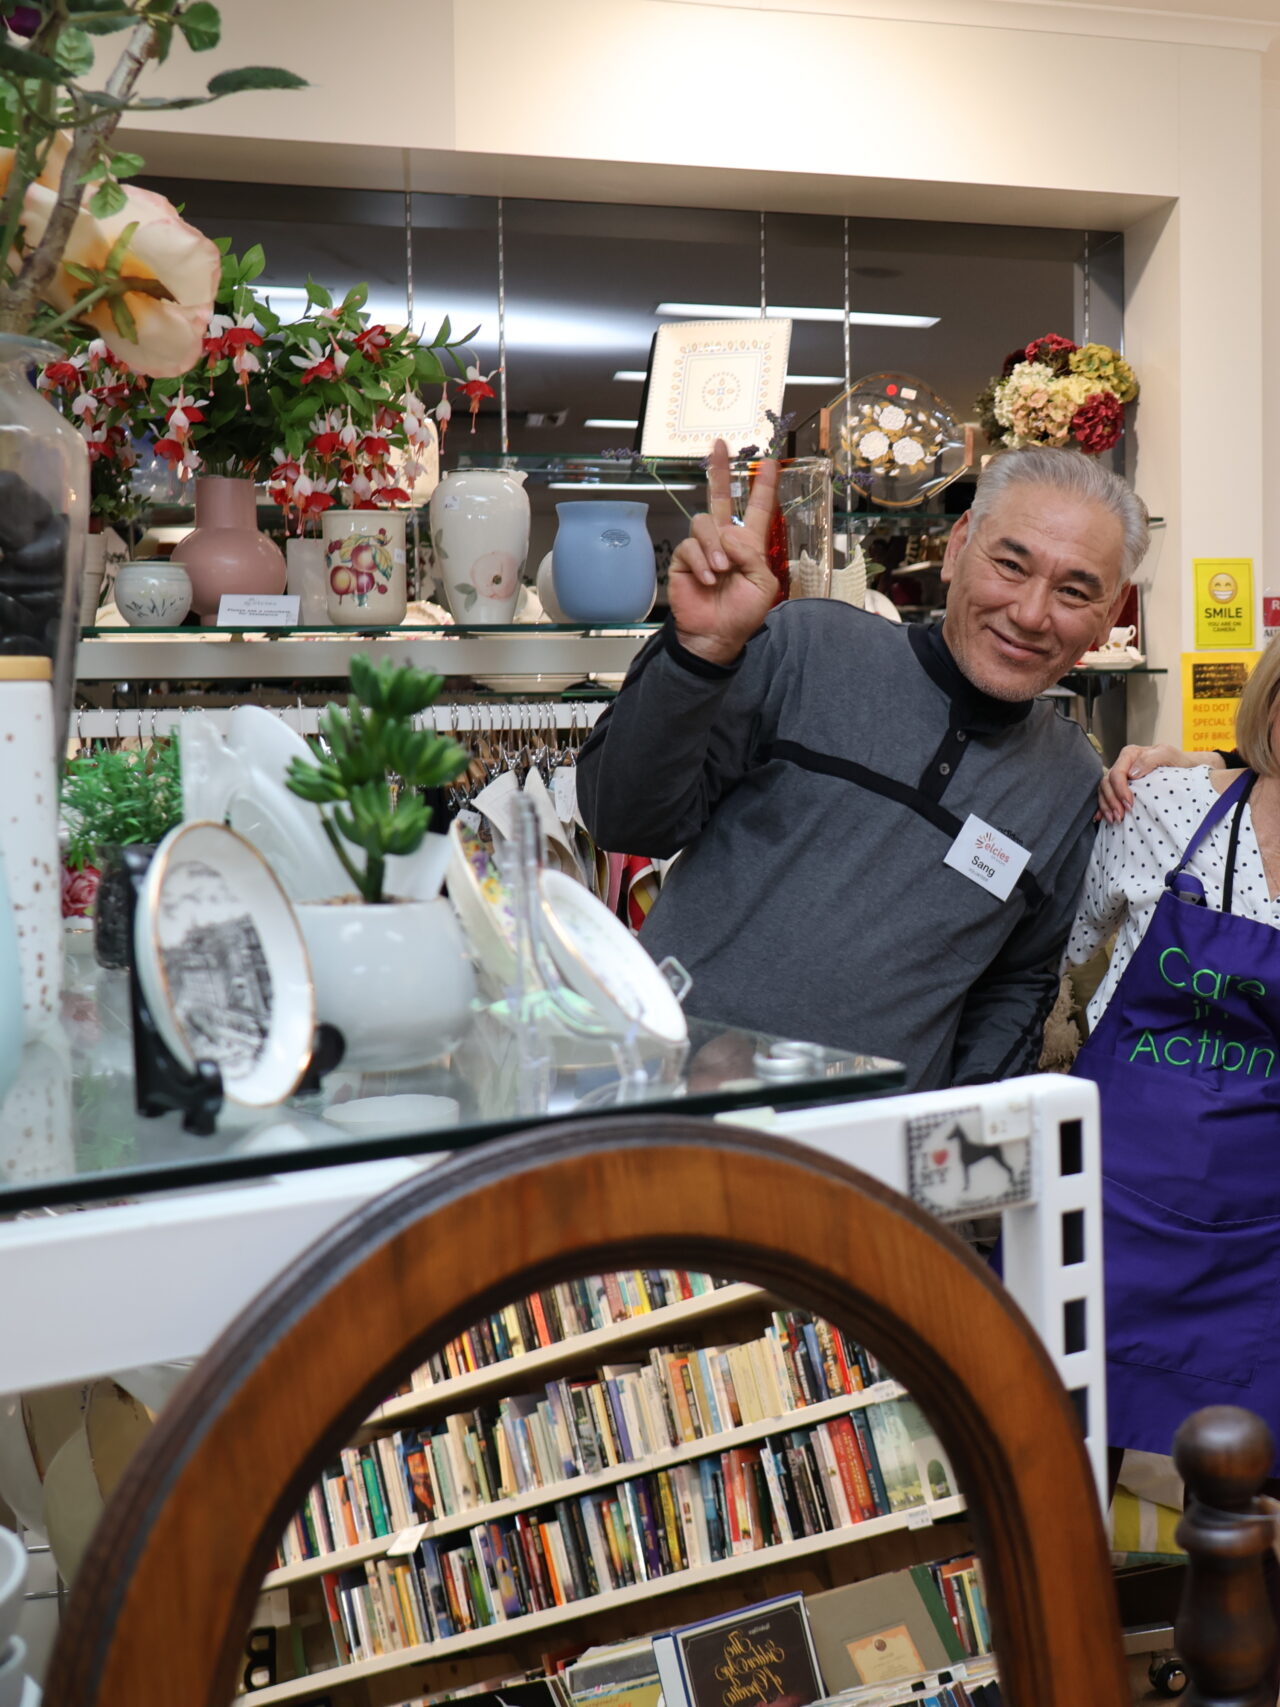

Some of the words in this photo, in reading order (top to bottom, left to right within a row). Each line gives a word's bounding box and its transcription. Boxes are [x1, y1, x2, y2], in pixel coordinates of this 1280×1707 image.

[1204, 607, 1243, 618] SMILE
[1193, 703, 1210, 712] RED
[1212, 703, 1229, 712] DOT
[1193, 718, 1226, 727] SPECIAL
[1193, 732, 1209, 741] OFF
[985, 842, 1010, 863] elcies
[971, 855, 996, 878] Sang
[1159, 947, 1266, 1000] Care
[1129, 1029, 1276, 1078] Action
